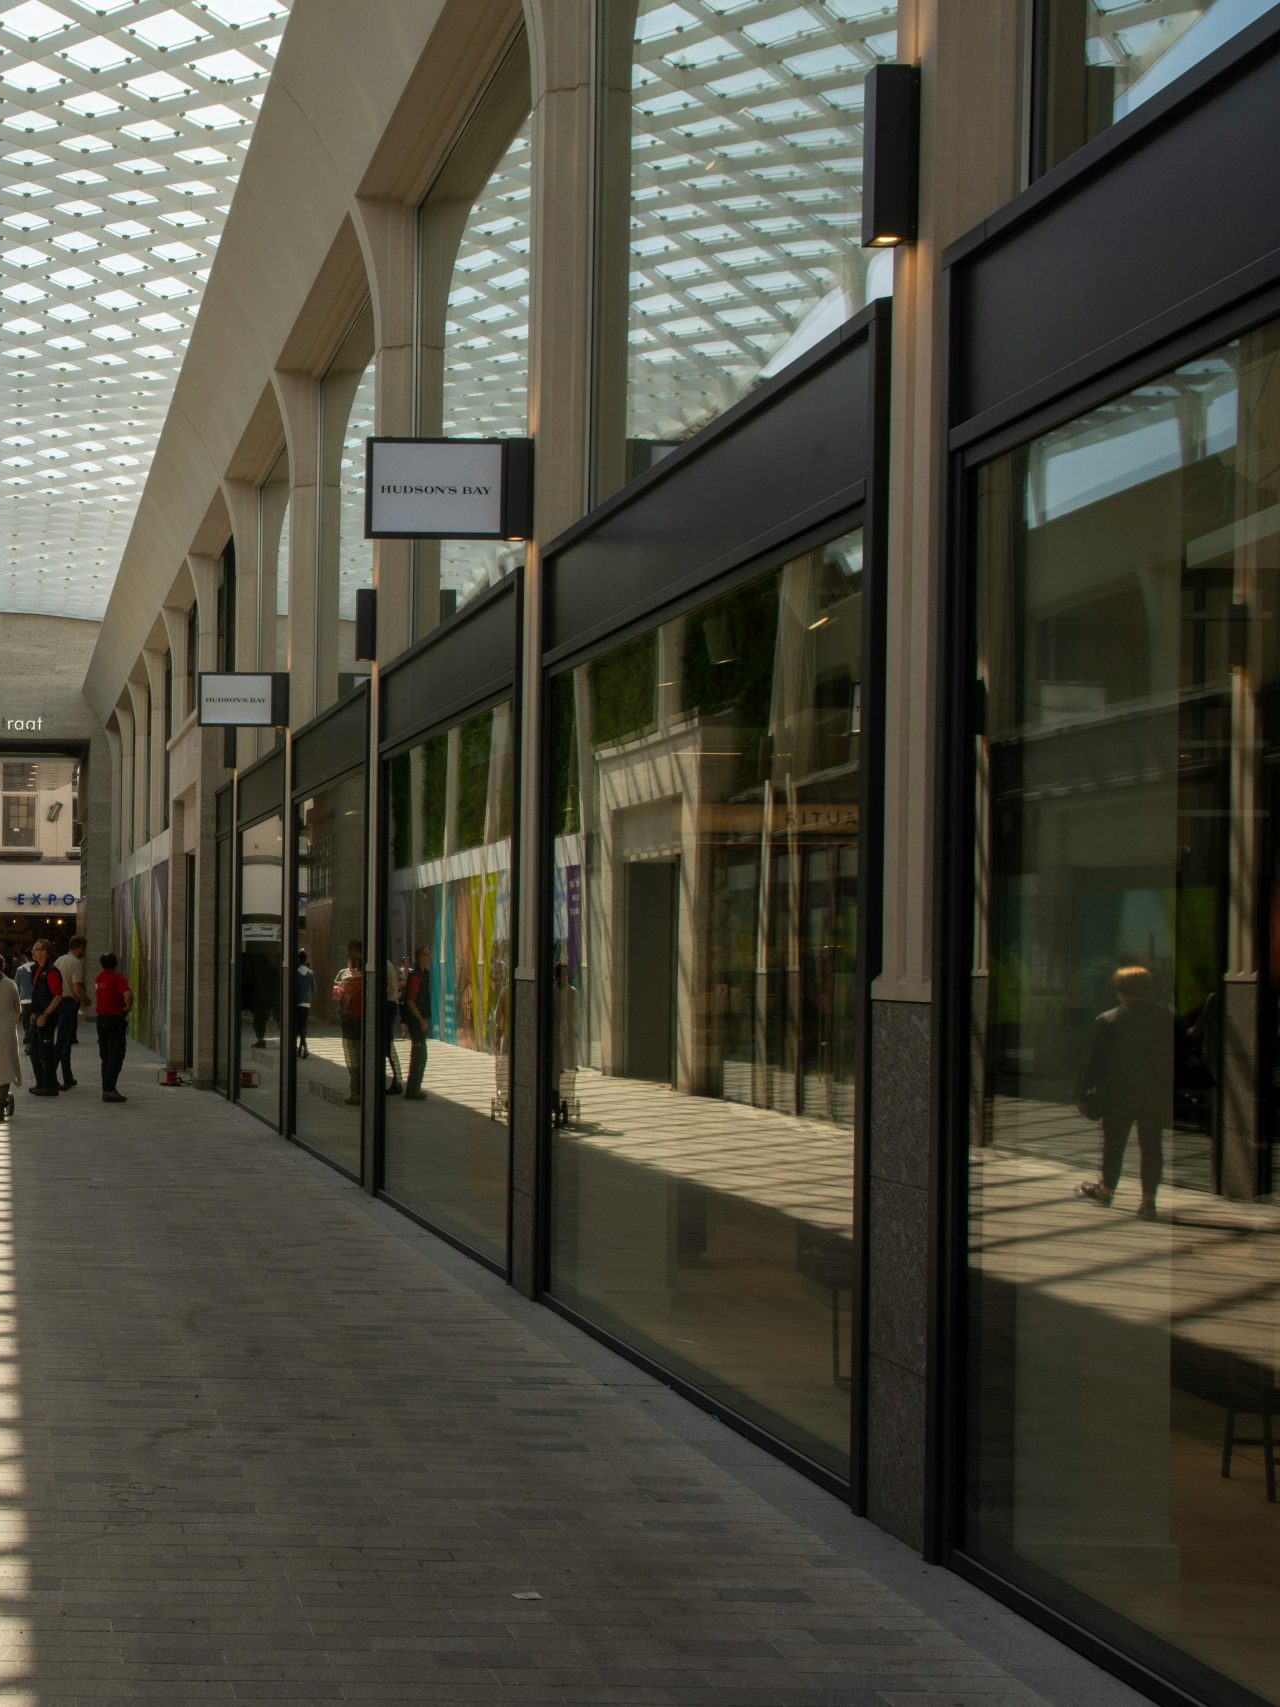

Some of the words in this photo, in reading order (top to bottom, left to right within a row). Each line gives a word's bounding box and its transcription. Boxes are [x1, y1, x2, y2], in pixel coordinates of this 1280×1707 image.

[380, 484, 458, 495] HUDSON'S
[462, 485, 492, 495] BAY
[17, 893, 75, 906] EXPO
